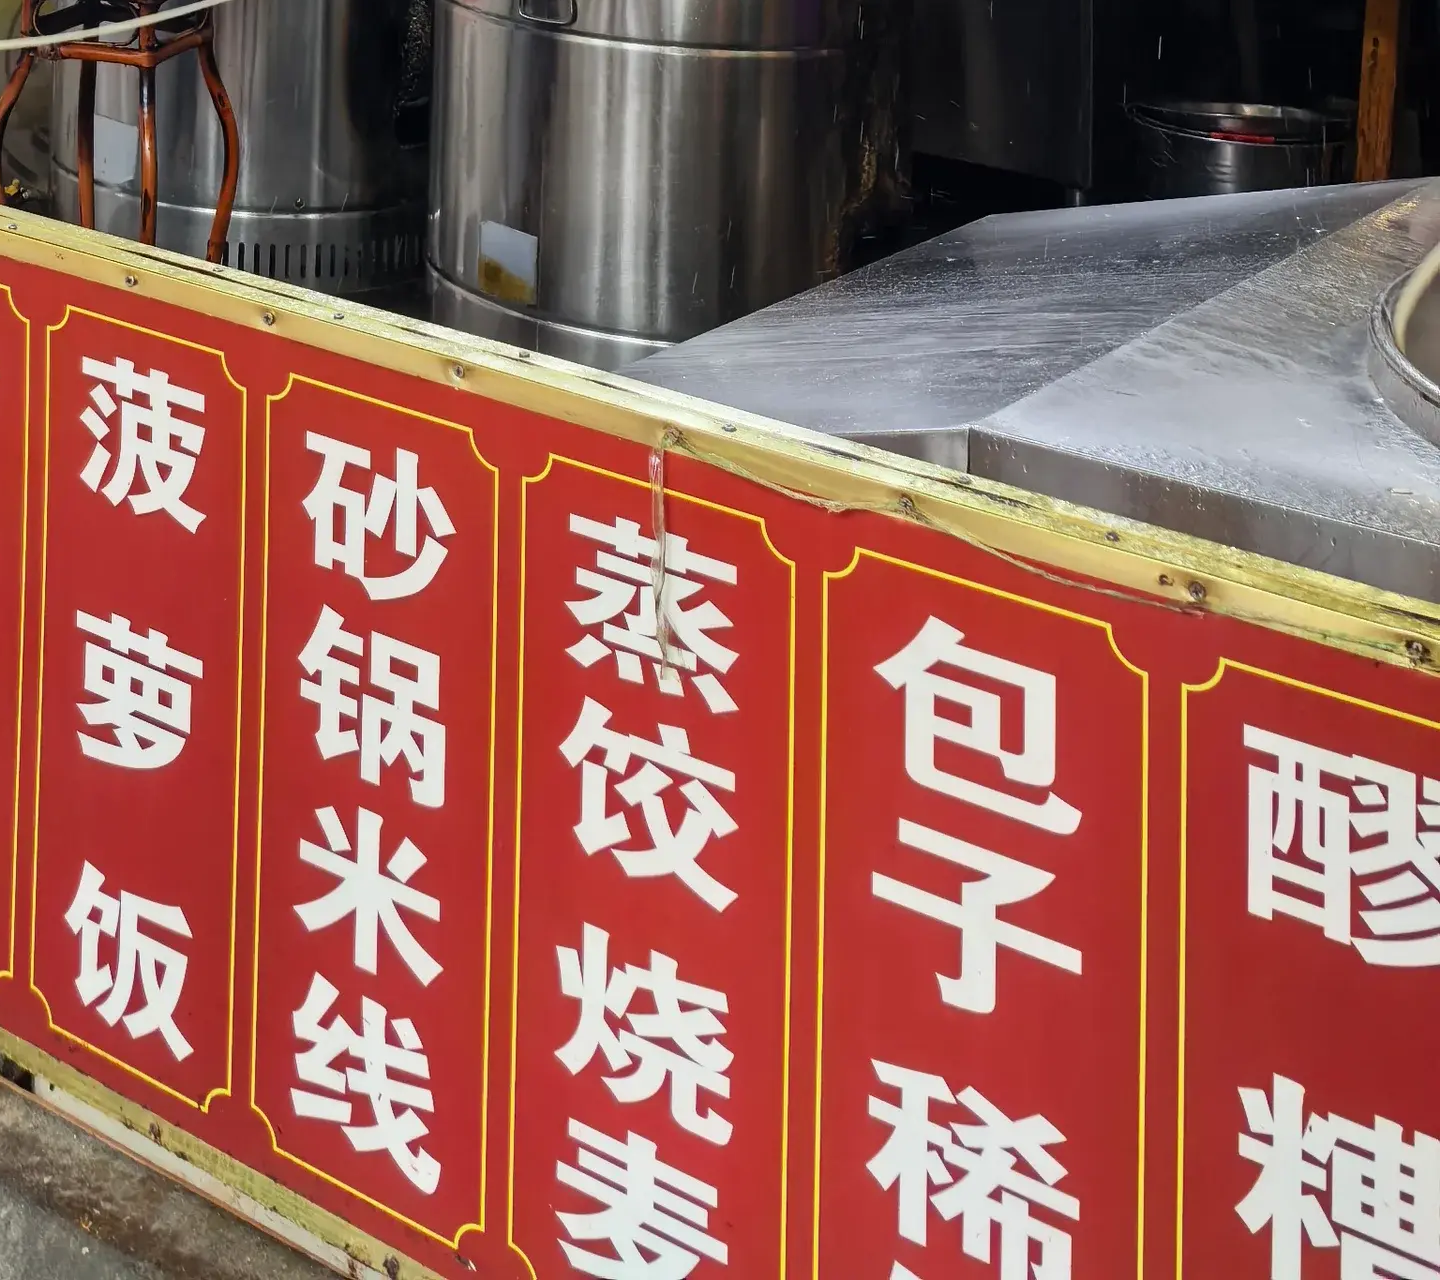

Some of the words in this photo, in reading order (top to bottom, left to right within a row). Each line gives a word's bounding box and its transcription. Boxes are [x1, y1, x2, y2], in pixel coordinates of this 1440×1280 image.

[65, 357, 206, 1061] 菠萝饭
[291, 431, 456, 1194] 砂锅米线
